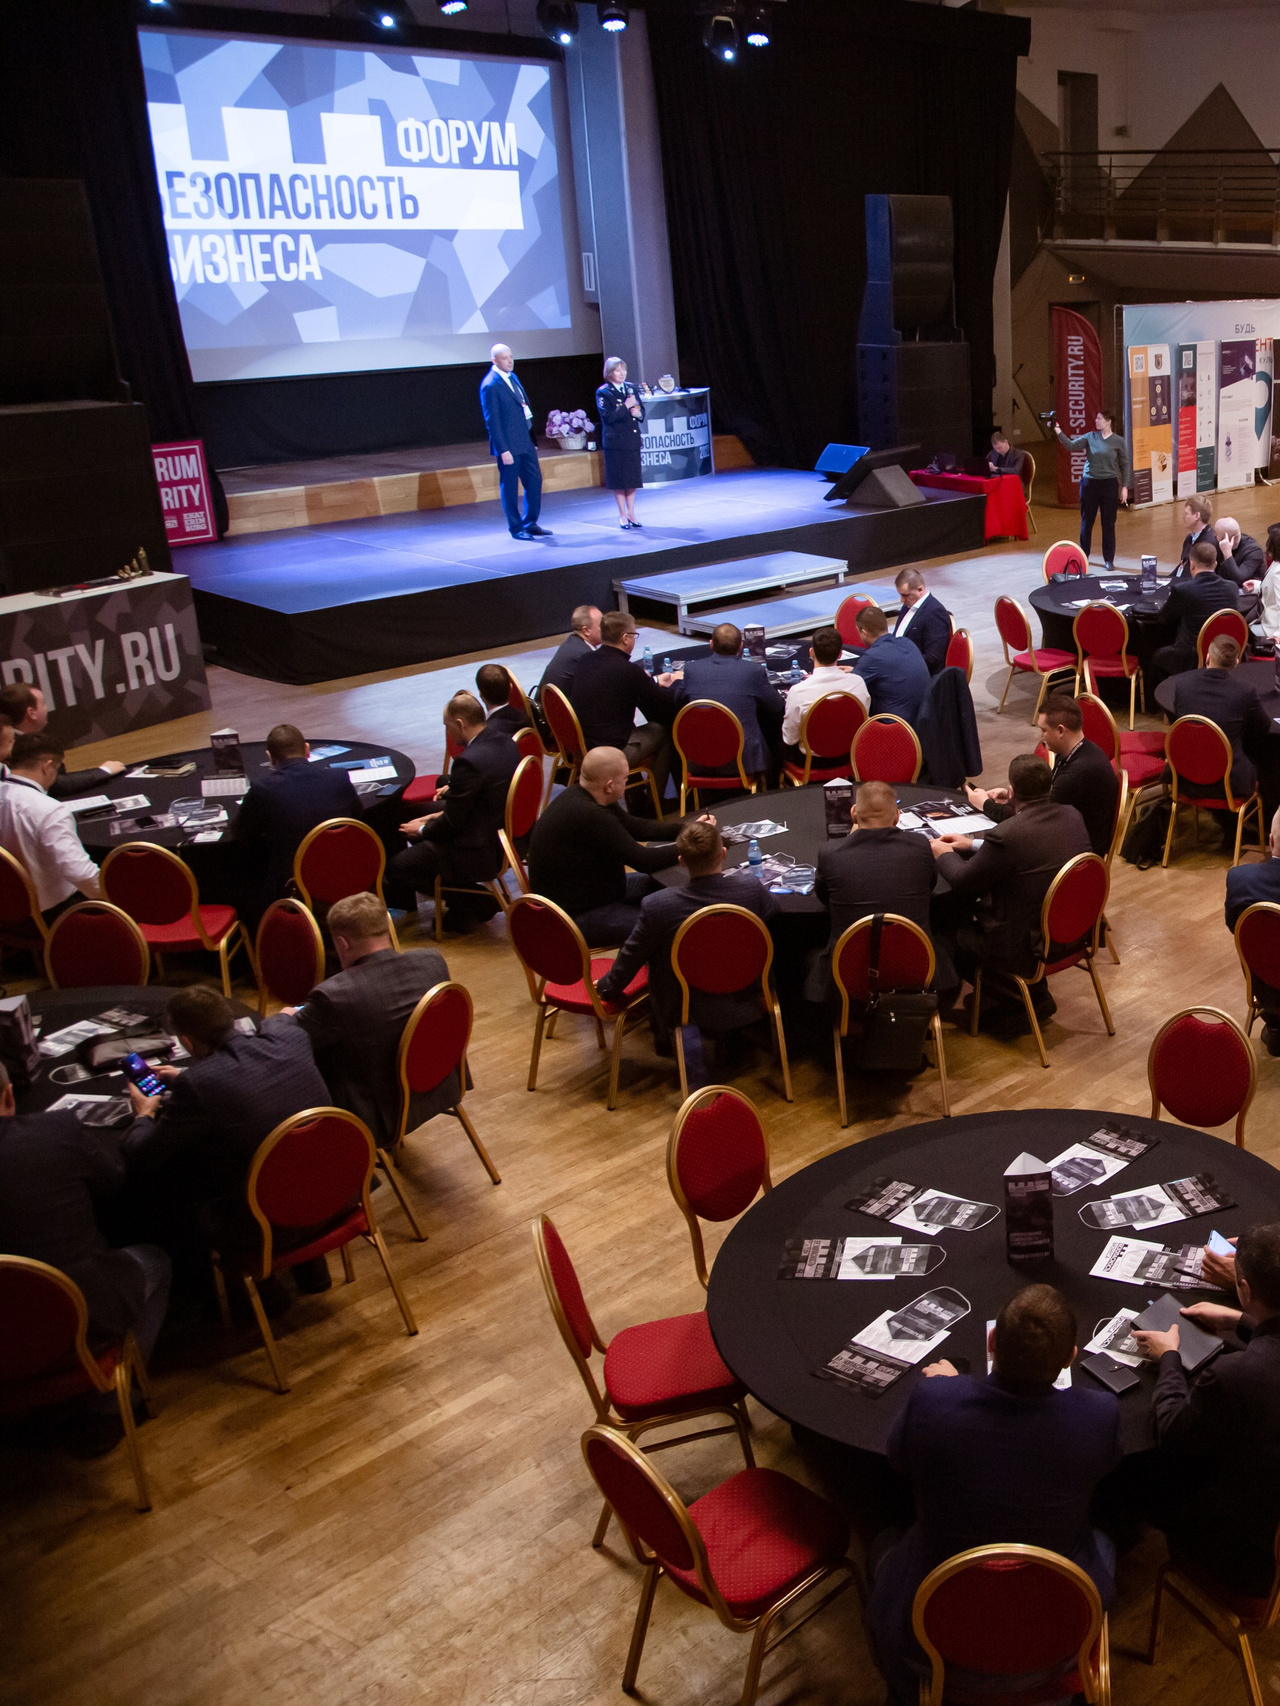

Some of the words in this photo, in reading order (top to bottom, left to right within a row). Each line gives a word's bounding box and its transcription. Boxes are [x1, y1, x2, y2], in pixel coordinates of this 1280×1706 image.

[397, 117, 519, 167] ФОРУМ
[161, 170, 420, 220] ЕЗОПАСНОСТЬ
[1234, 323, 1256, 334] БУДЬ
[1067, 335, 1087, 483] FORU-SECURITY.RU
[155, 454, 199, 483] RUM
[161, 484, 201, 510] RITY
